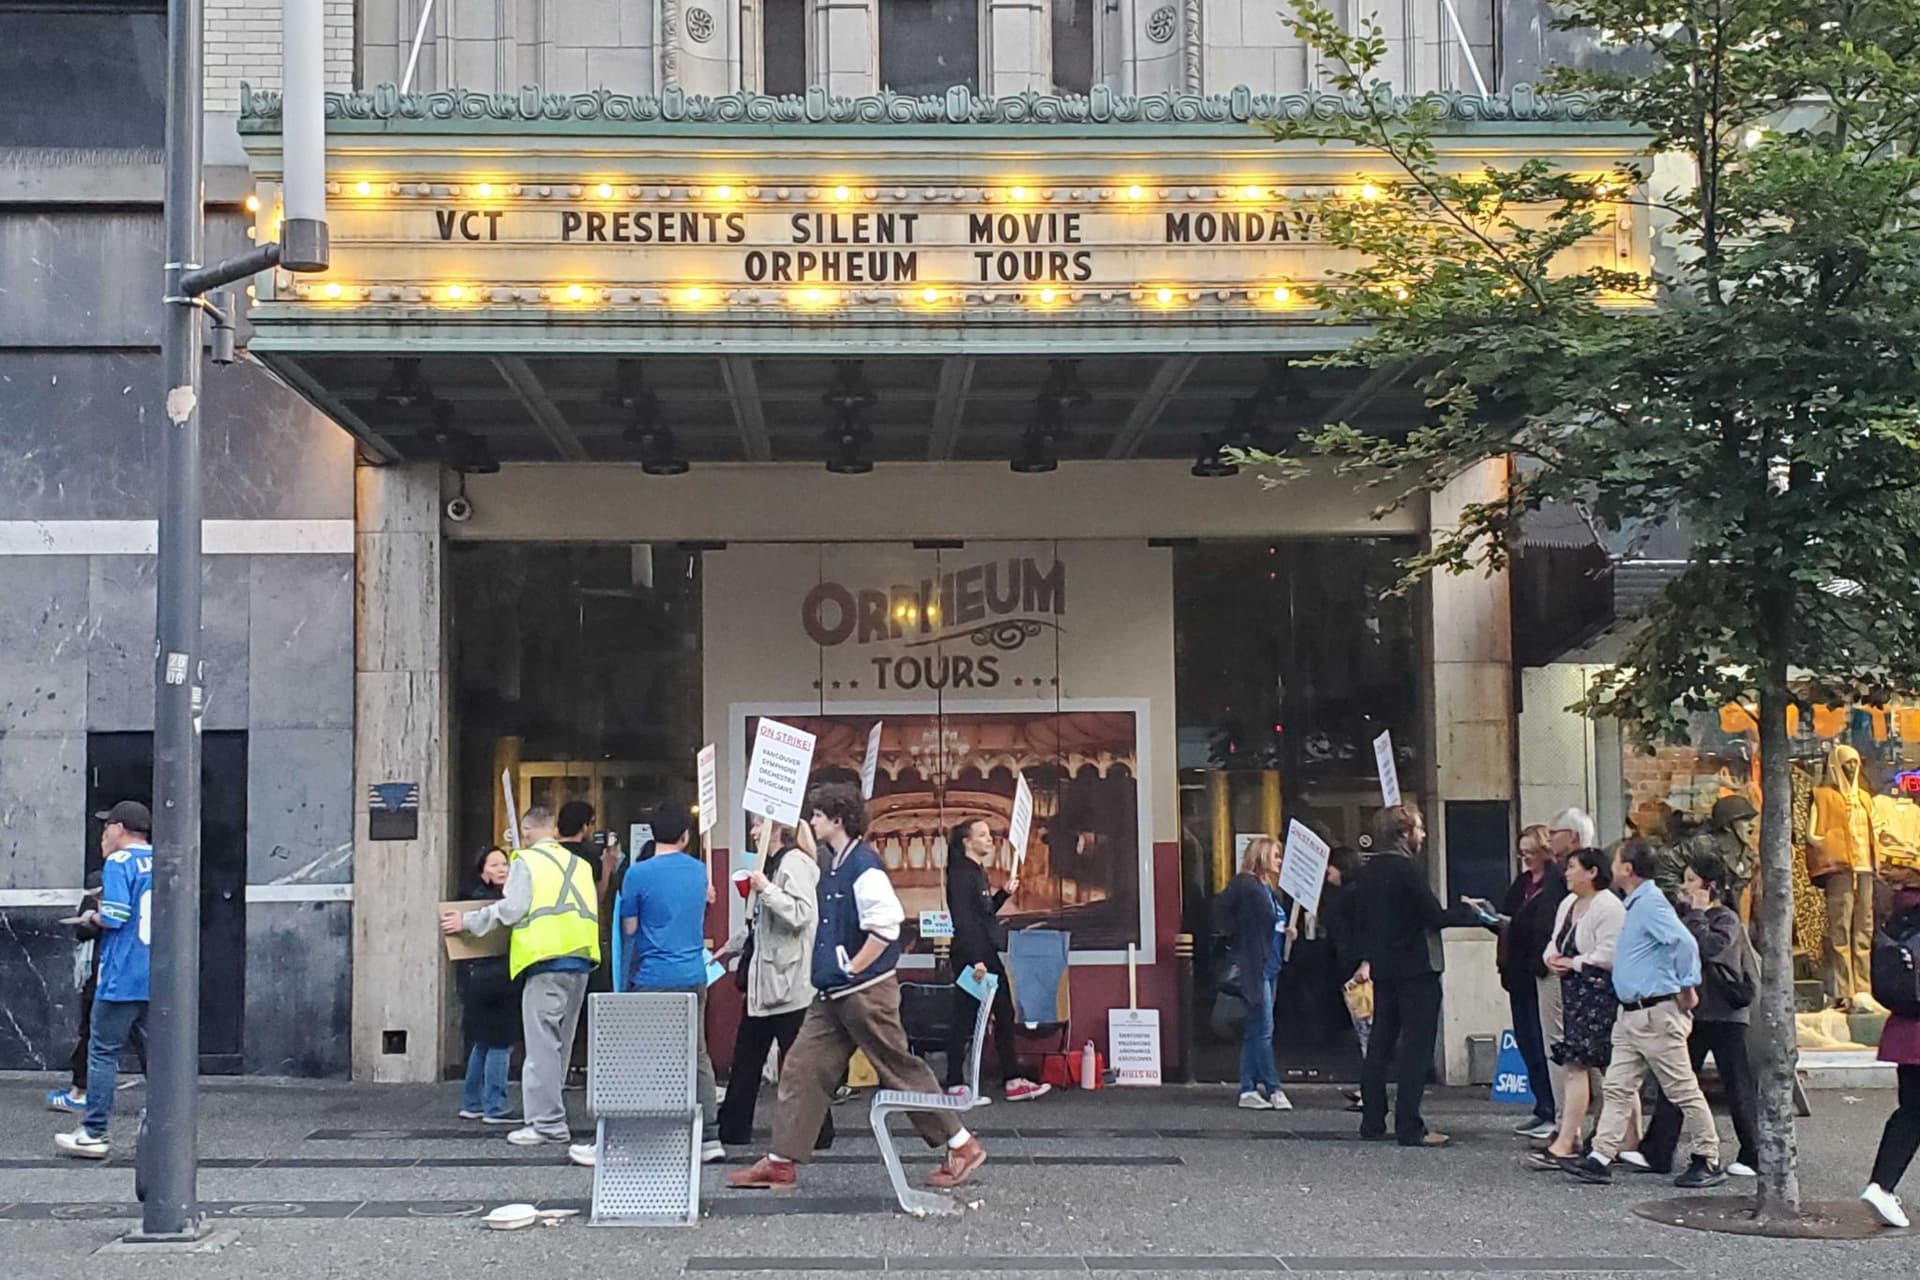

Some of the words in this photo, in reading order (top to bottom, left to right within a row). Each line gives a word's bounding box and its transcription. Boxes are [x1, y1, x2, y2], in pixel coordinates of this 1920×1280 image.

[436, 210, 503, 241] VCT
[562, 211, 746, 243] PRESENTS
[791, 212, 919, 244] SILENT
[969, 212, 1081, 244] MOVIE
[745, 251, 917, 282] ORPHEUM
[974, 250, 1092, 282] TOURS
[802, 557, 1065, 647] ORPHEUM
[871, 655, 1000, 690] TOURS
[760, 725, 775, 738] ON
[776, 731, 812, 752] STRIKE!
[761, 758, 798, 775] SYMPHONY
[762, 748, 801, 766] VANCOUVER
[758, 776, 793, 794] MUSICIANS
[759, 767, 796, 785] ORCHESTRA
[1145, 1070, 1159, 1079] ON
[1495, 1073, 1528, 1094] SAVE
